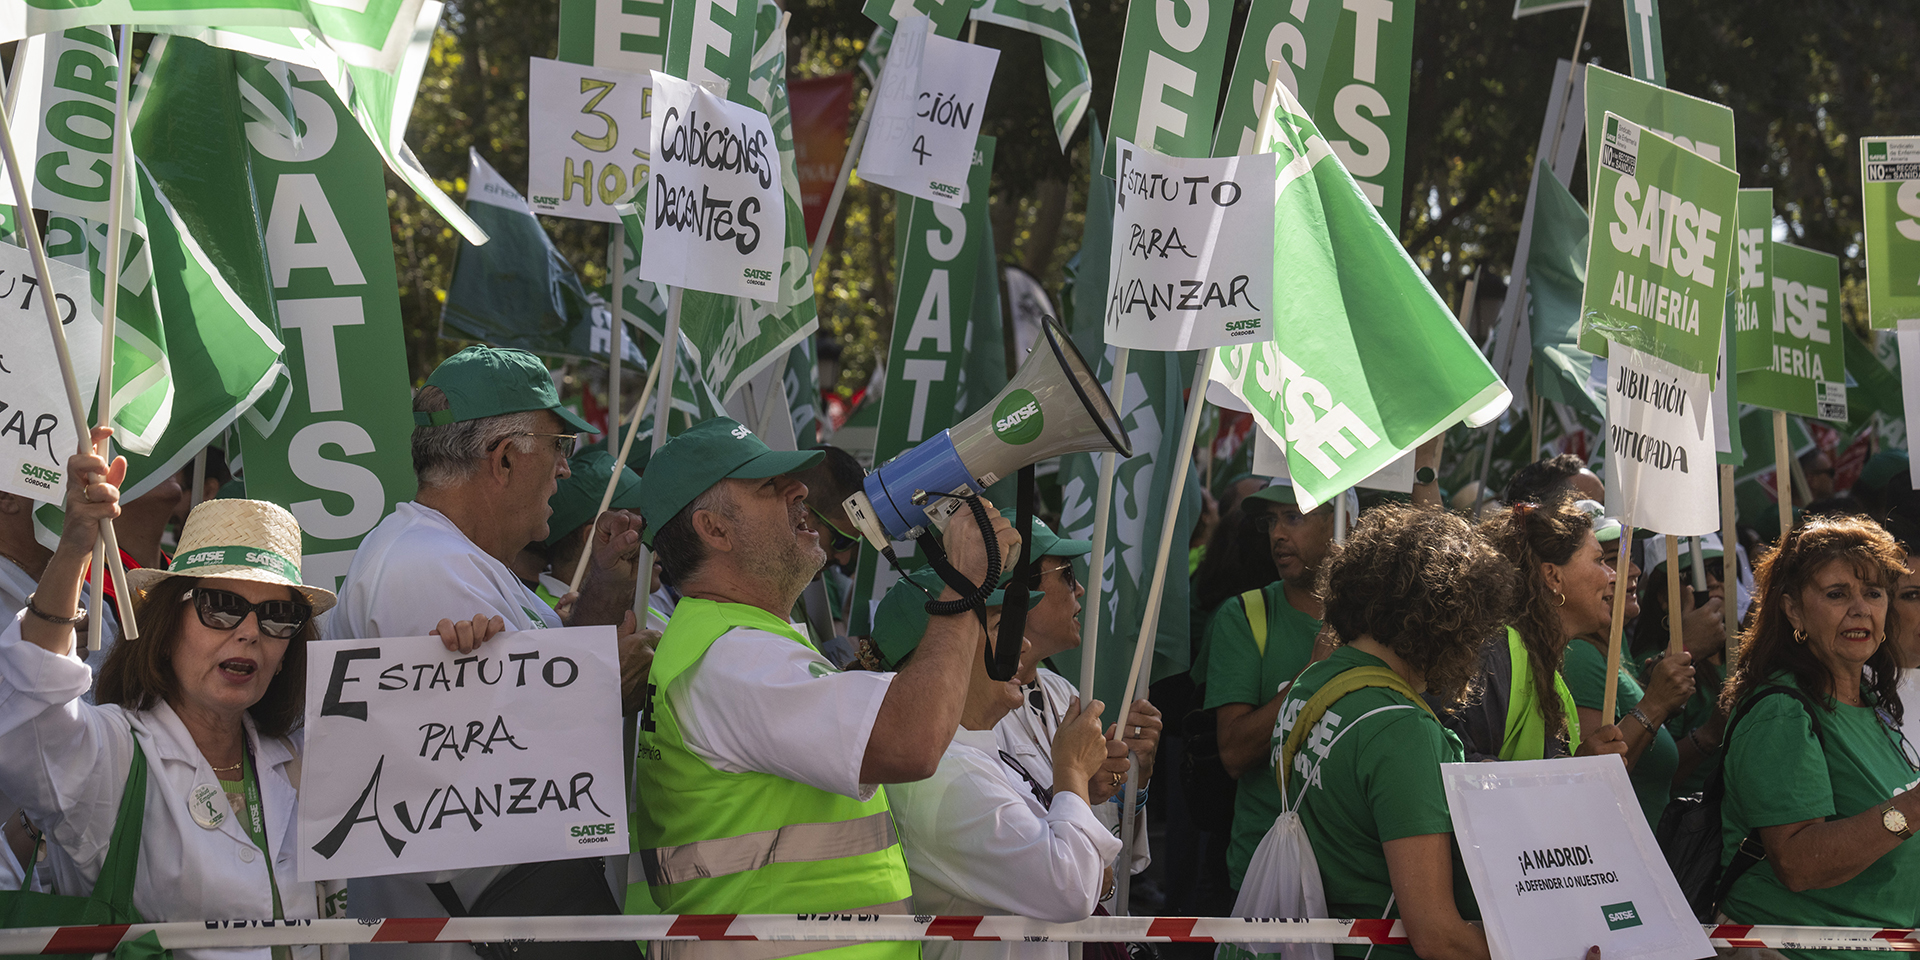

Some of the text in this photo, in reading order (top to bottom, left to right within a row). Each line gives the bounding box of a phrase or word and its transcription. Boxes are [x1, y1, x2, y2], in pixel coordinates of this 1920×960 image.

[1603, 145, 1613, 166] NO
[1118, 149, 1242, 210] ESTATUTO
[1869, 165, 1885, 180] NO
[533, 195, 560, 206] SATSE
[929, 181, 960, 196] SATSE
[1129, 223, 1197, 259] PARA
[1609, 175, 1722, 287] SATSE
[743, 268, 772, 281] SATSE
[1107, 243, 1260, 332] AVANZAR
[1610, 270, 1700, 336] ALMERÍA
[1772, 275, 1831, 344] TSE
[1225, 318, 1261, 332] SATSE
[1230, 328, 1256, 338] CÓRDOBA
[1616, 365, 1688, 417] JUBILACIÓN
[996, 401, 1039, 432] SATSE
[1610, 424, 1689, 474] NTICIPADA
[21, 462, 62, 485] SATSE
[24, 477, 51, 490] CÓRDOBA
[186, 551, 225, 565] SATSE
[245, 552, 284, 570] SATSE
[321, 647, 579, 721] ESTATUTO
[419, 715, 527, 761] PARA
[250, 804, 262, 833] SATSE
[312, 755, 610, 859] AVANZAR
[570, 823, 615, 837] SATSE
[578, 836, 608, 844] CÓRDOBA
[1518, 845, 1593, 876] ¡A MADRID!
[1515, 871, 1619, 896] ¡A DEFENDER LO NUESTRO!
[1608, 910, 1635, 922] SATSE
